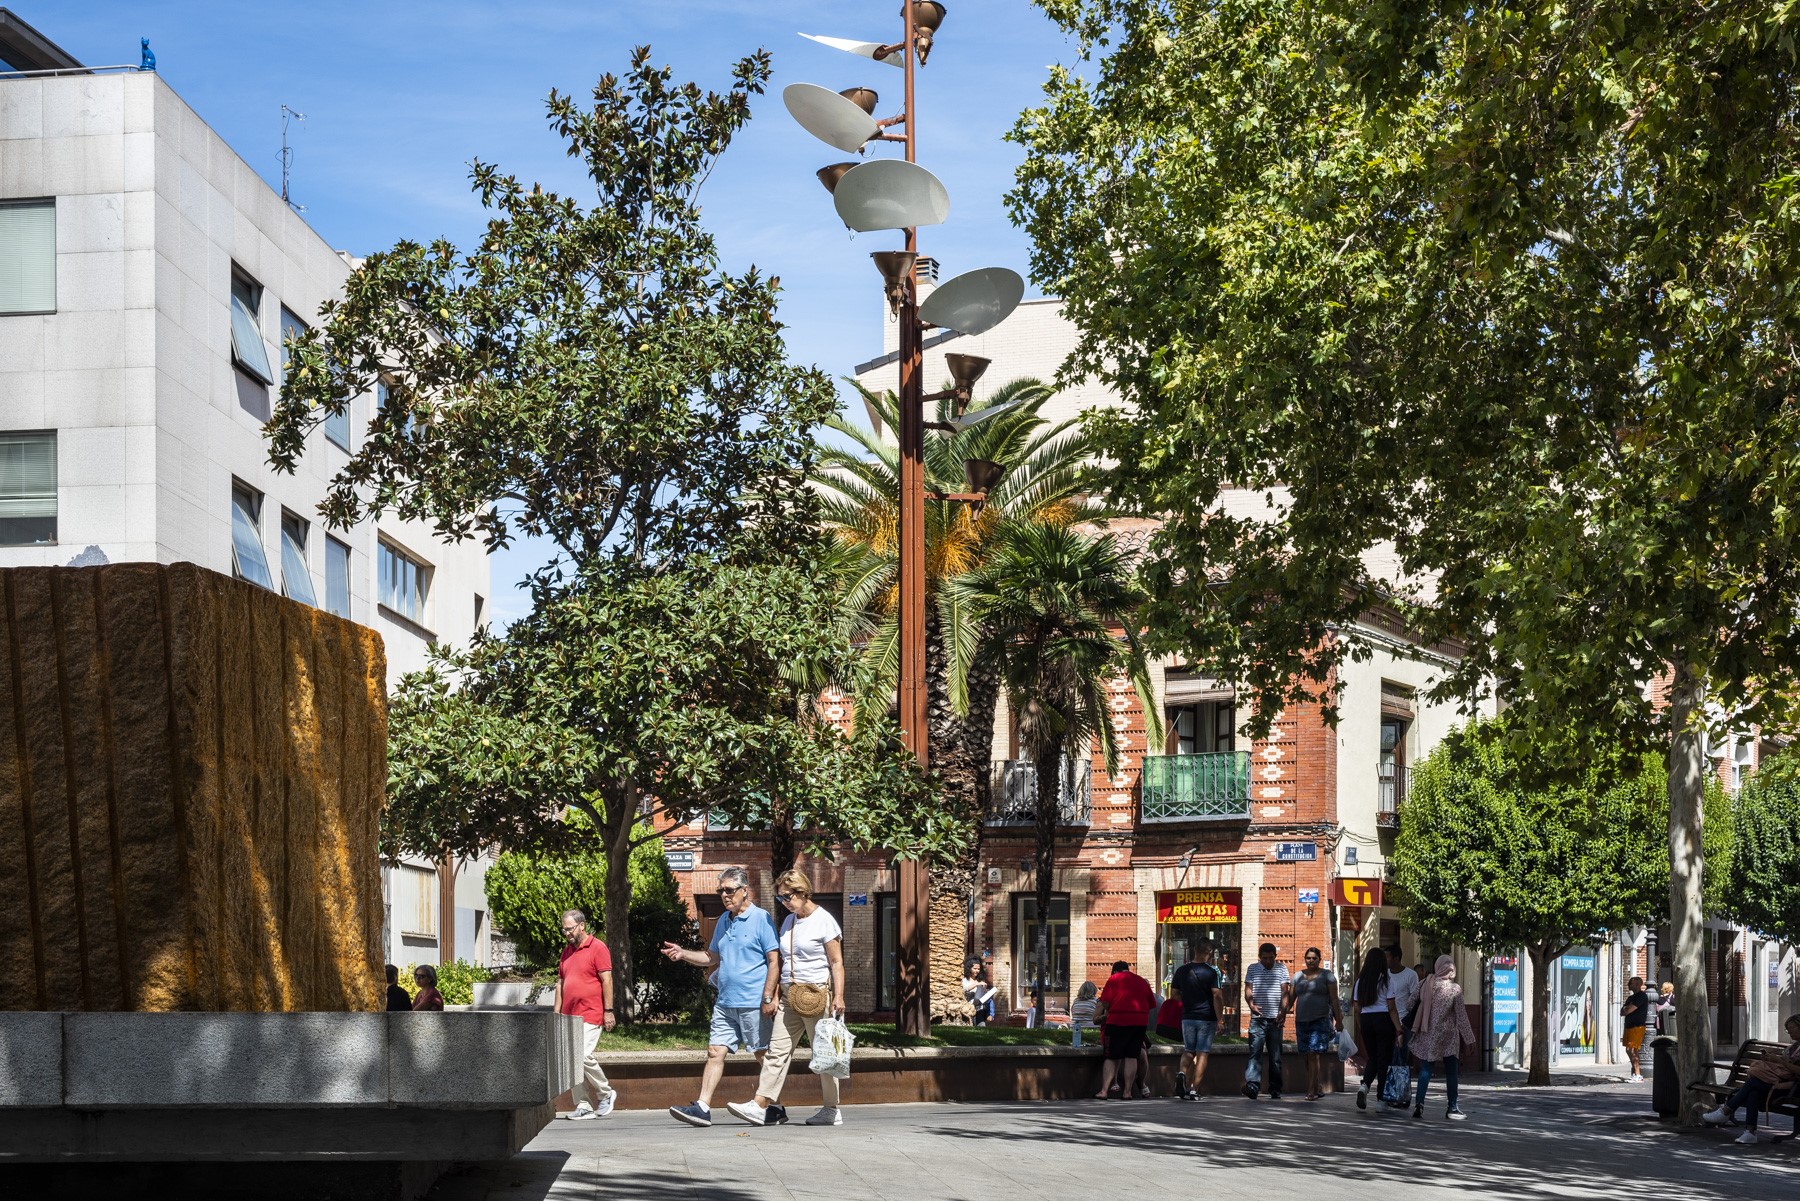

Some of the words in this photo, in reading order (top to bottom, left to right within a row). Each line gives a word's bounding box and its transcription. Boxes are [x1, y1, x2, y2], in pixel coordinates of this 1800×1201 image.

[1176, 892, 1224, 903] PRENSA
[1173, 904, 1227, 916] REVISTAS
[1563, 958, 1579, 967] COMPRA
[1579, 959, 1585, 968] DE
[1585, 959, 1594, 968] ORO
[1494, 987, 1516, 997] EXCHANGE
